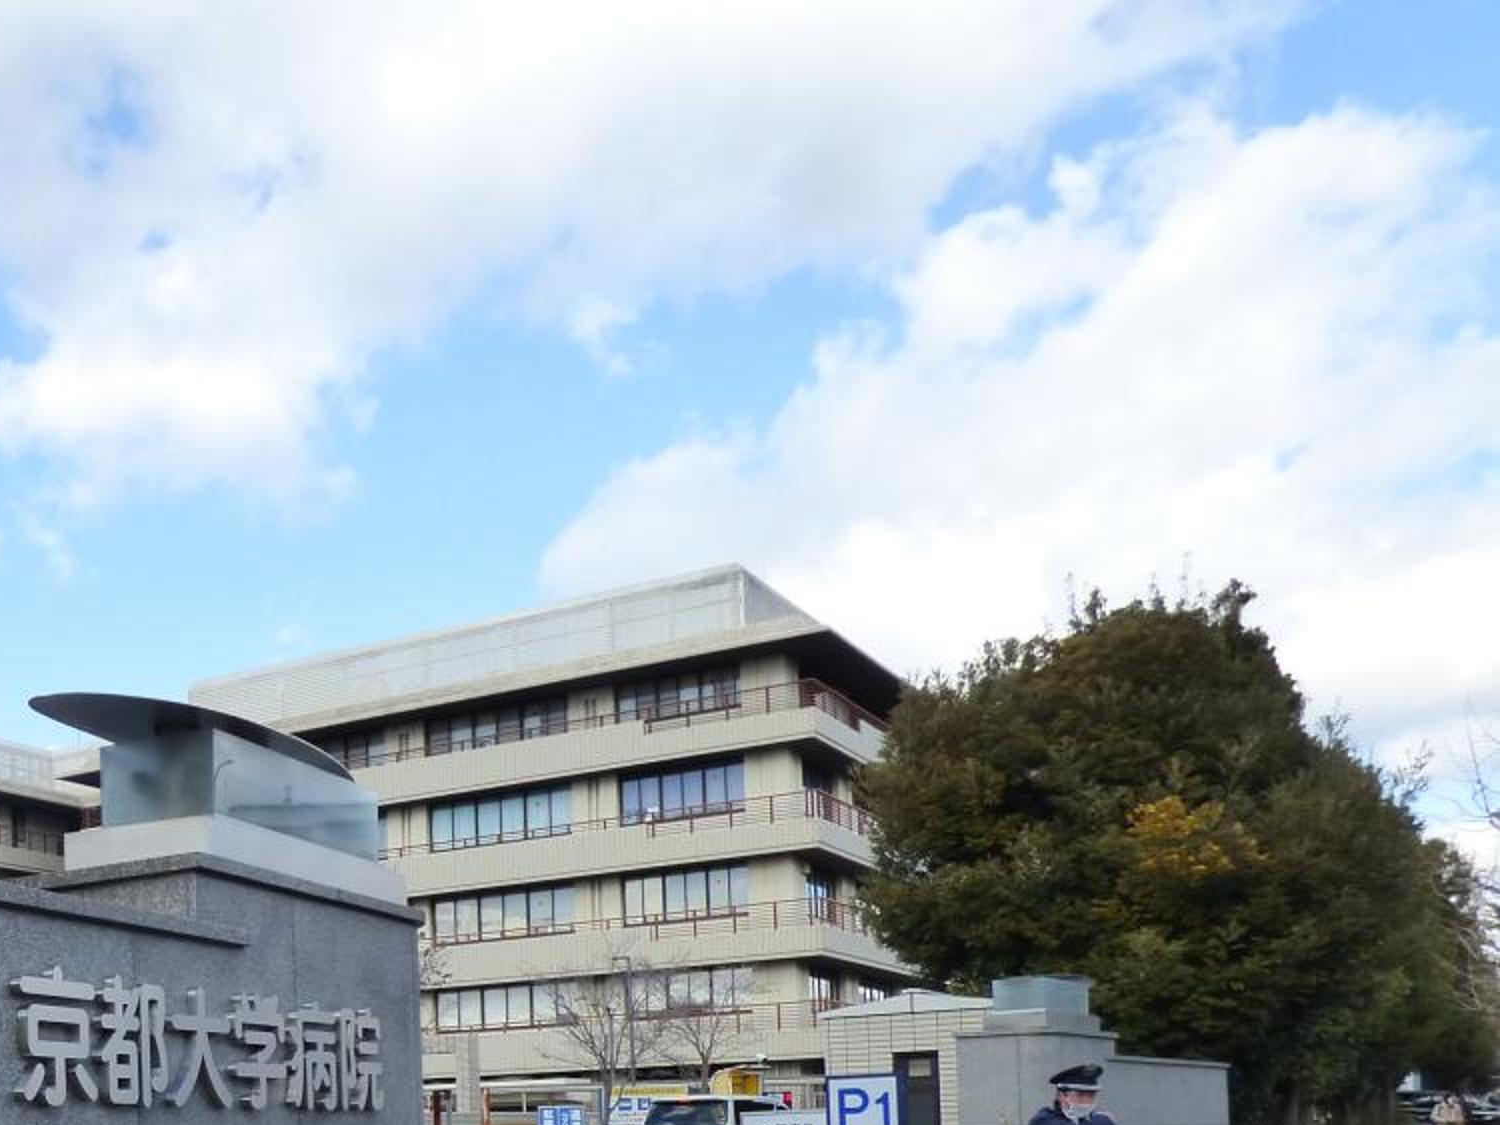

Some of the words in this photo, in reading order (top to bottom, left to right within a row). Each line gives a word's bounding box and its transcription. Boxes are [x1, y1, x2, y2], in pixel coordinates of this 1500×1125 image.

[10, 964, 384, 1111] 京都大学病院
